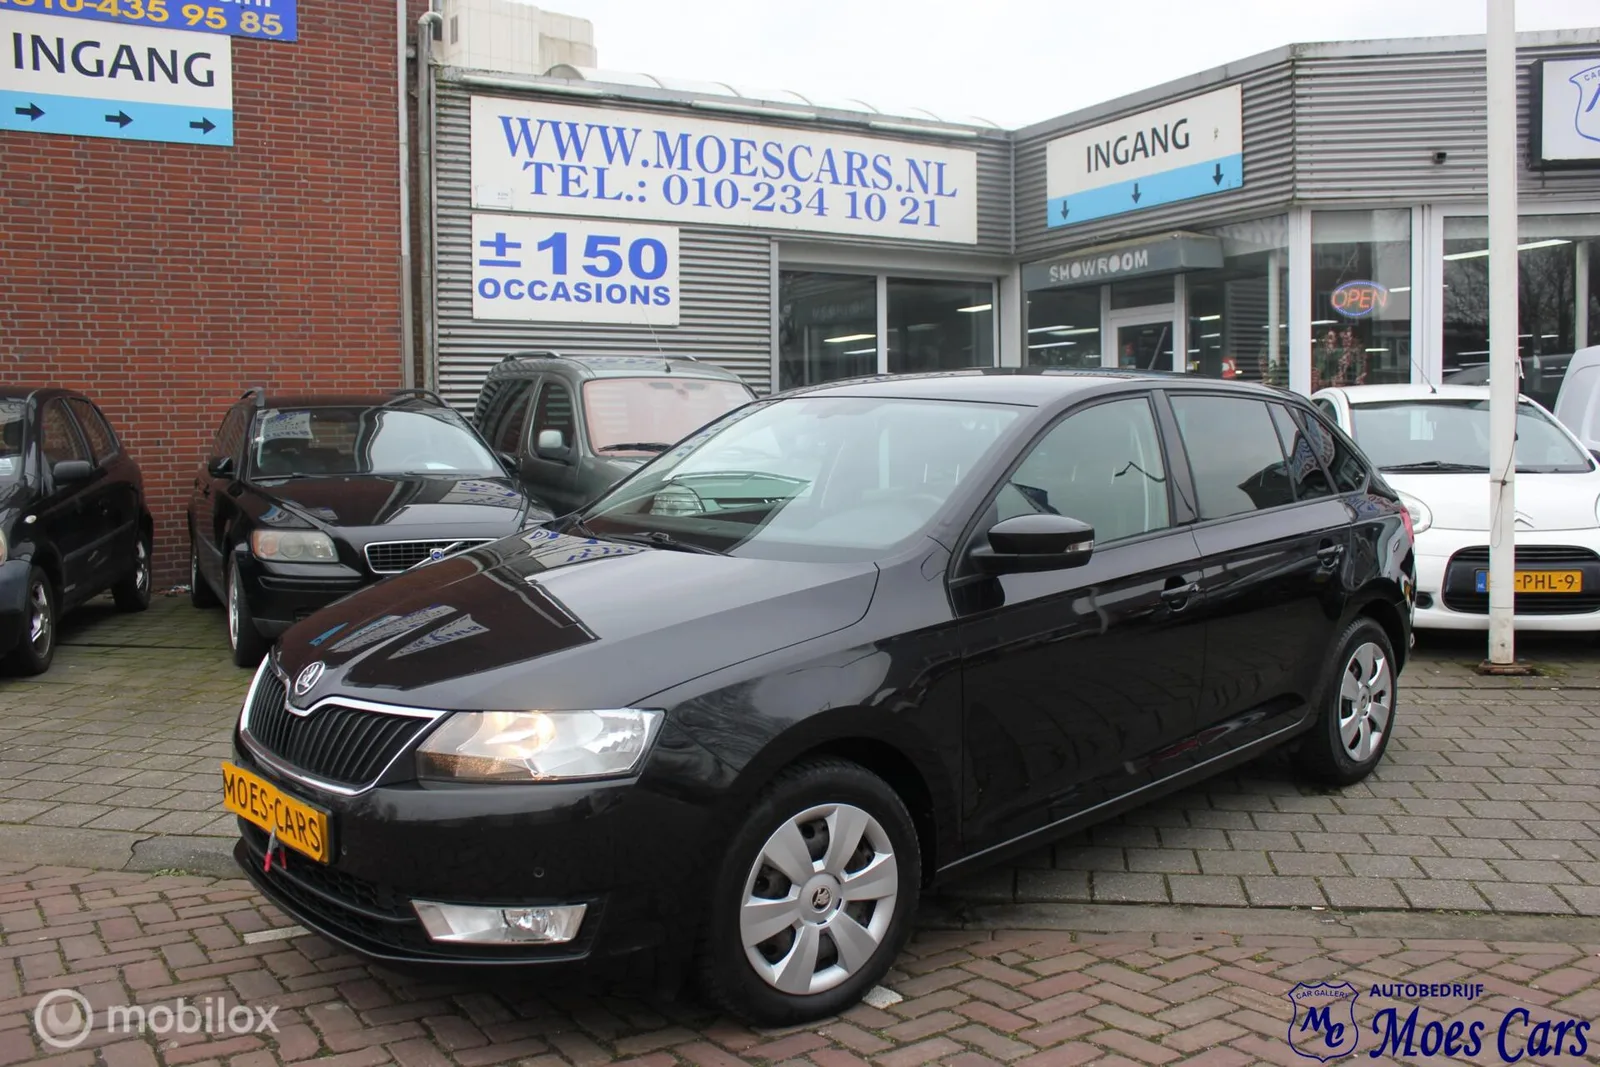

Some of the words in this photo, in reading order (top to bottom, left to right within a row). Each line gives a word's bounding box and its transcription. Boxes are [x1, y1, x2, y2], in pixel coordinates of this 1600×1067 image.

[181, 4, 227, 29] 95
[239, 11, 283, 36] 85
[12, 32, 214, 87] INGANG
[498, 115, 958, 198] WWW.MOESCARS.NL
[1087, 118, 1190, 173] INGANG
[522, 161, 648, 203] TEL.:
[662, 174, 829, 217] 010-234
[844, 193, 887, 222] 10
[899, 197, 941, 228] 21
[536, 232, 668, 280] 150
[1049, 250, 1148, 282] SHOWROOM
[478, 279, 671, 306] OCCASIONS
[1331, 288, 1388, 309] OPEN
[1516, 574, 1575, 590] -PHL-9
[222, 769, 321, 853] MOES-CARS
